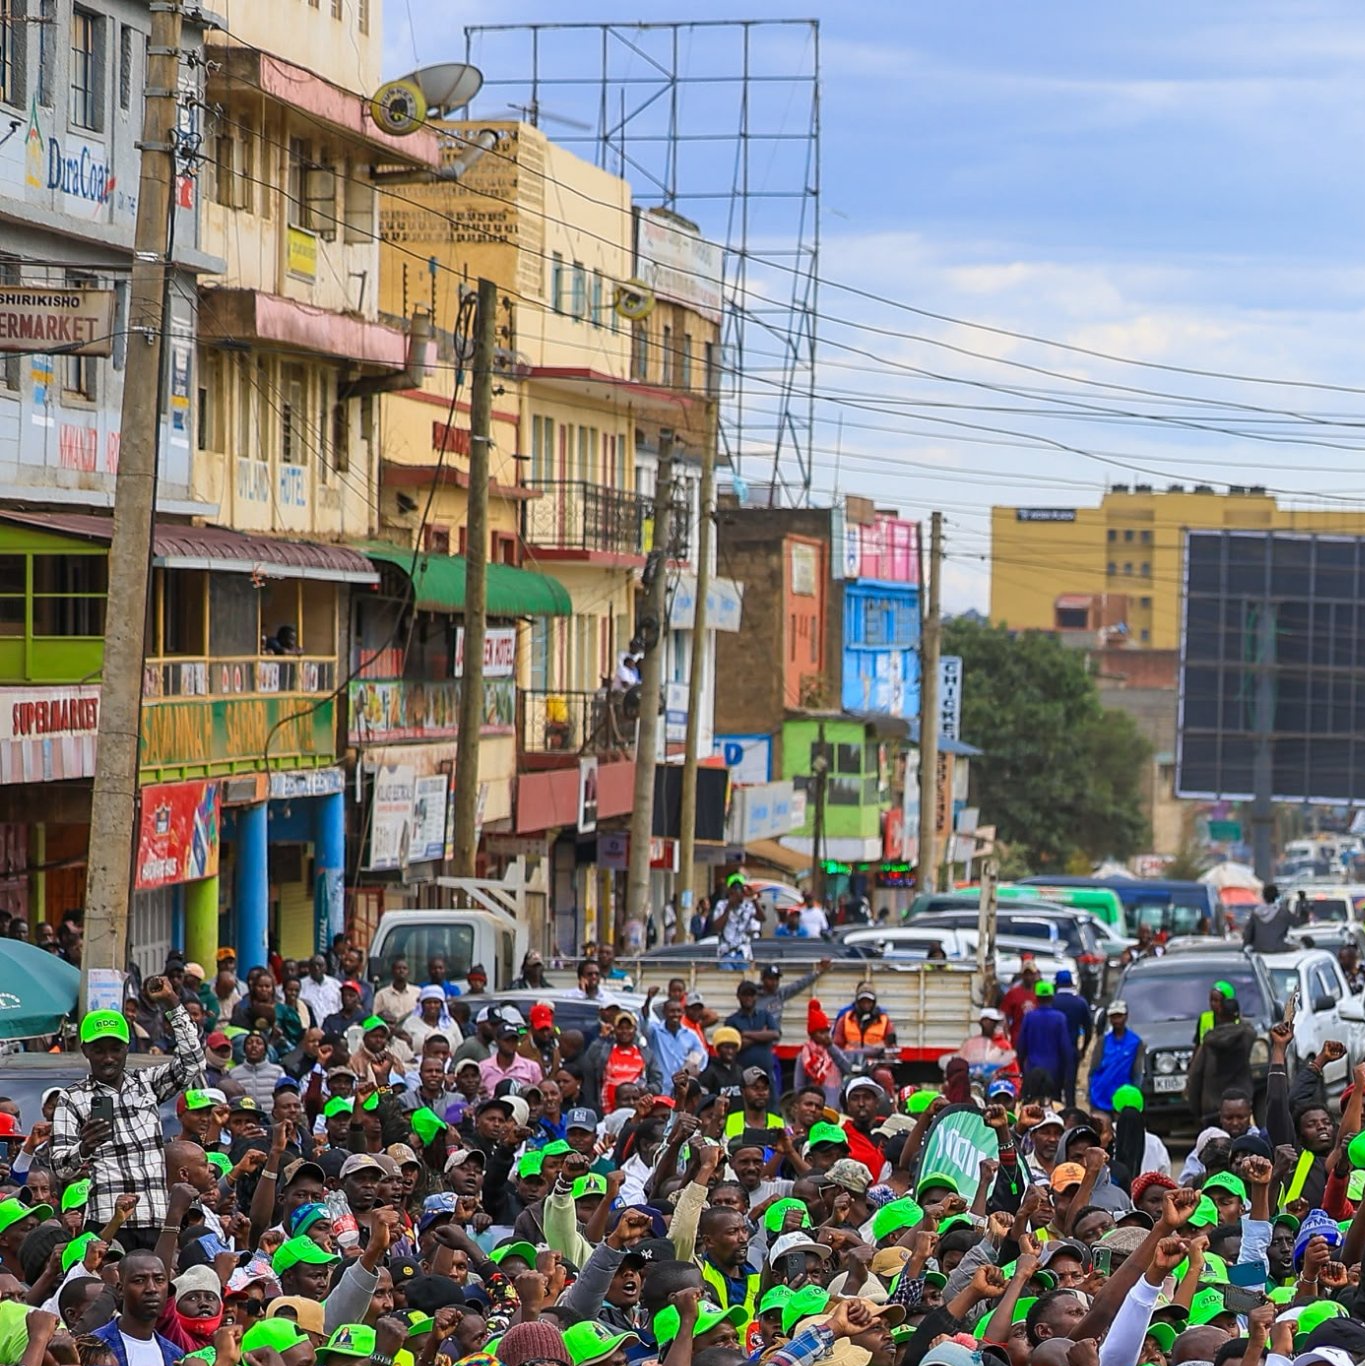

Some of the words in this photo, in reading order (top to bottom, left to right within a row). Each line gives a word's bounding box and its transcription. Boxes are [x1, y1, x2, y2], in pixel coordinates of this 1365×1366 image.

[0, 293, 80, 308] SHIRIKISHO
[13, 698, 99, 737] SUPERMARKET
[942, 664, 957, 740] CHICKE
